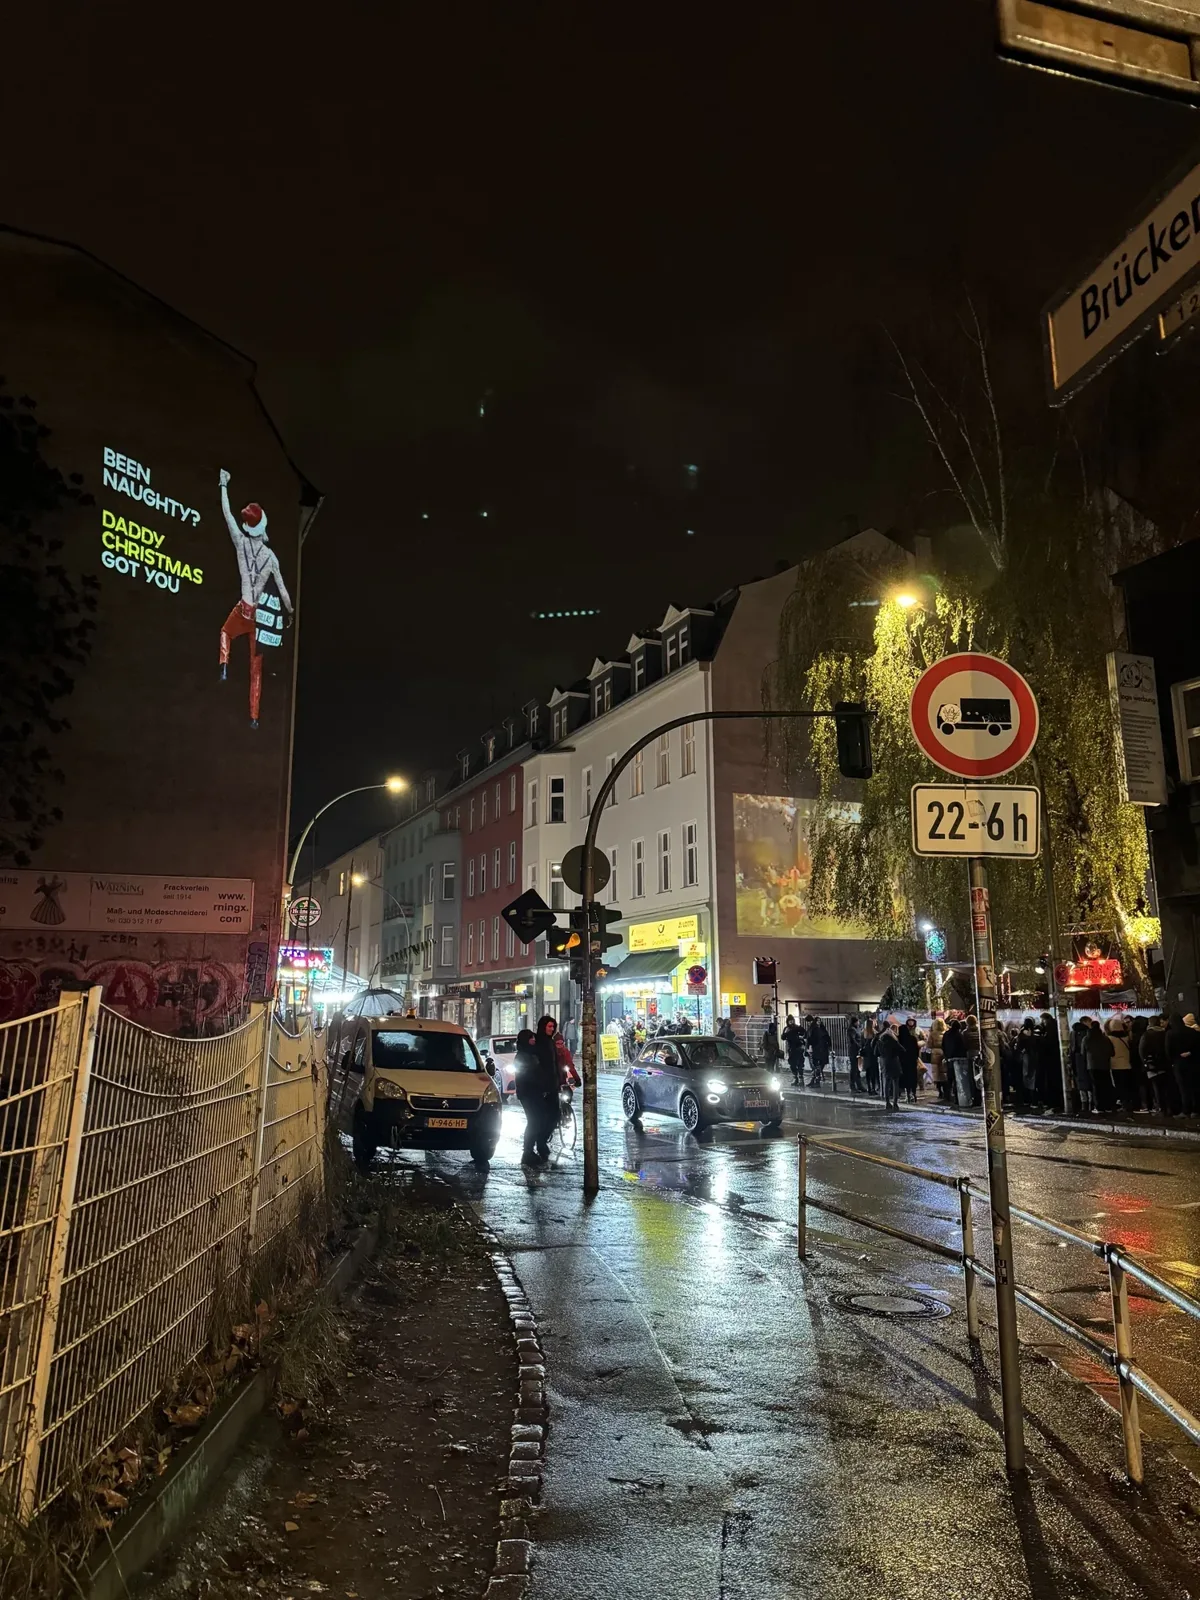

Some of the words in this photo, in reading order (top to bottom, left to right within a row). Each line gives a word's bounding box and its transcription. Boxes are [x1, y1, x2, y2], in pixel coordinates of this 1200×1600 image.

[103, 446, 151, 485] BEEN
[103, 467, 201, 527] NAUGHTY?
[102, 508, 165, 549] DADDY
[101, 531, 204, 585] CHRISTMAS
[101, 550, 140, 578] GOT
[144, 565, 180, 593] YOU
[1012, 802, 1028, 842] h
[163, 883, 210, 893] Frackverleih
[218, 892, 246, 901] www.
[106, 907, 126, 915] Maß-
[127, 908, 142, 916] und
[144, 908, 208, 917] Modeschneiderei
[219, 915, 242, 924] com
